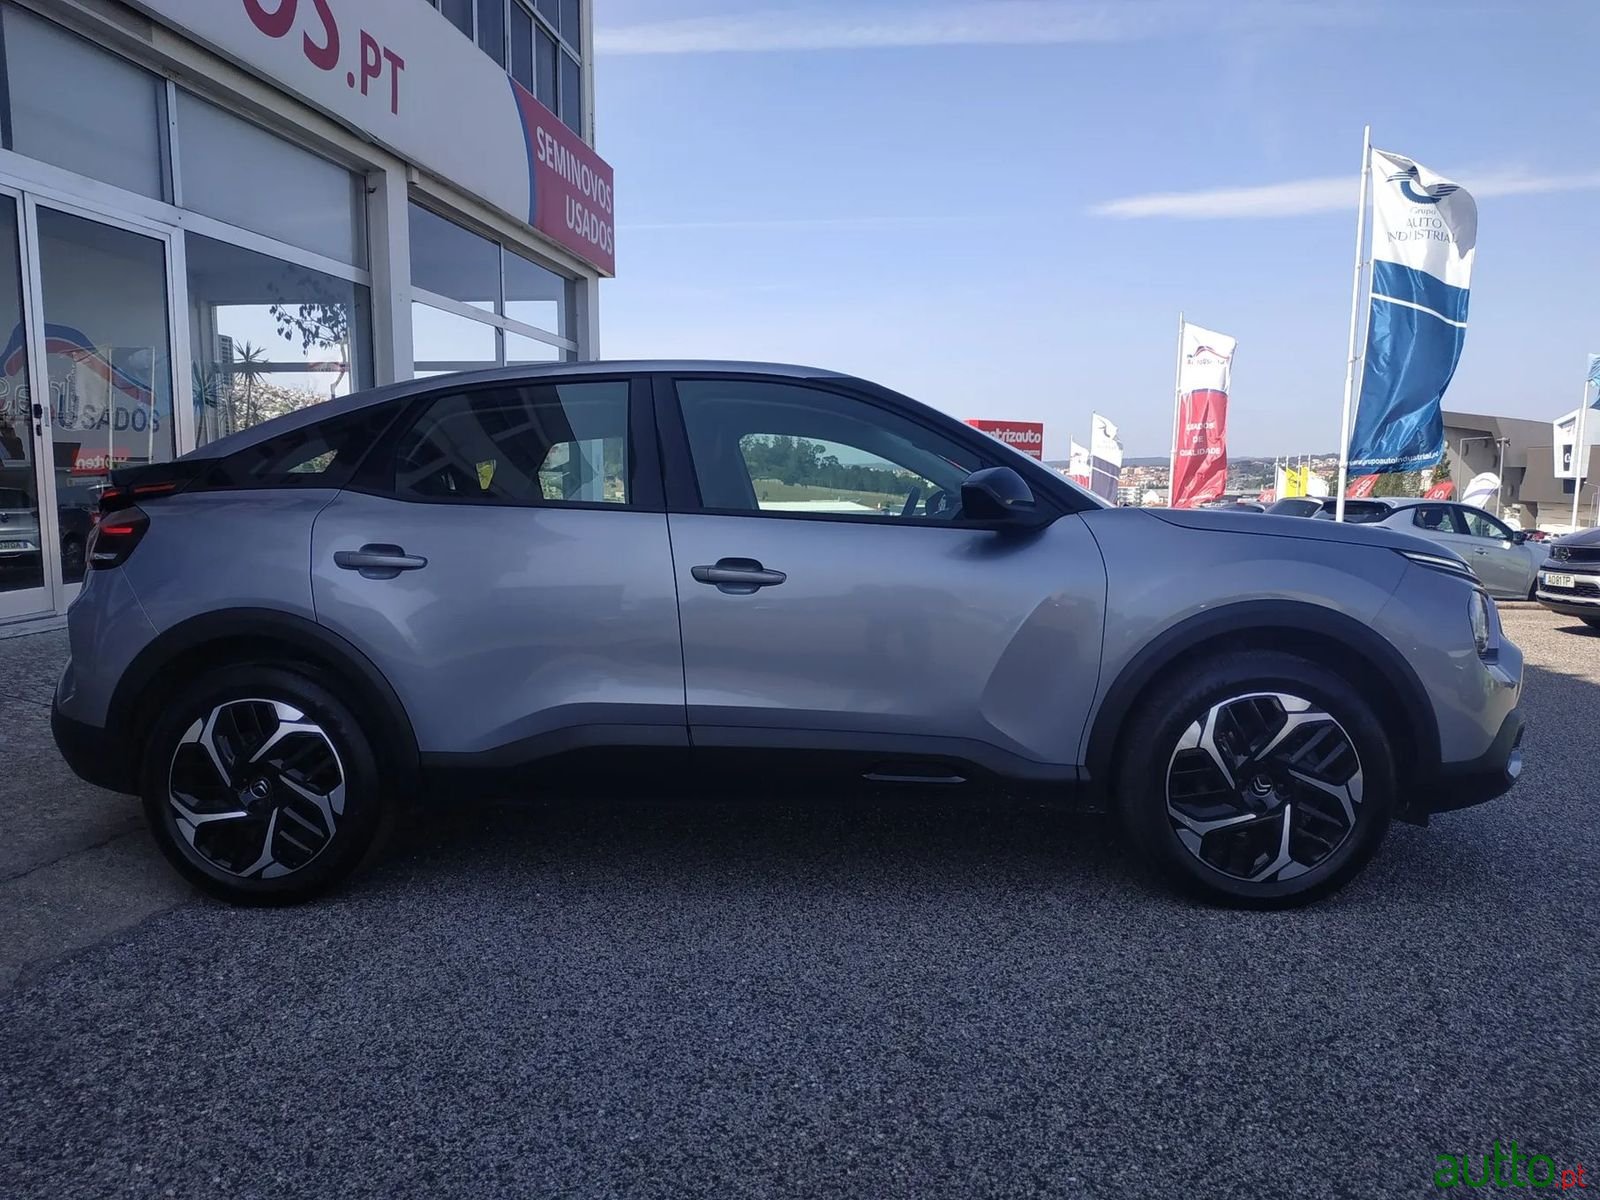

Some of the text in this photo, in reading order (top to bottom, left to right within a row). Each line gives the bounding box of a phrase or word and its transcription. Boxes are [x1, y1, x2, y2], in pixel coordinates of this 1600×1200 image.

[536, 126, 612, 215] SEMINOVOS
[566, 195, 613, 256] USADOS
[1406, 217, 1442, 229] AUTO
[1192, 435, 1204, 444] DE
[1179, 446, 1221, 457] QUALIDADE
